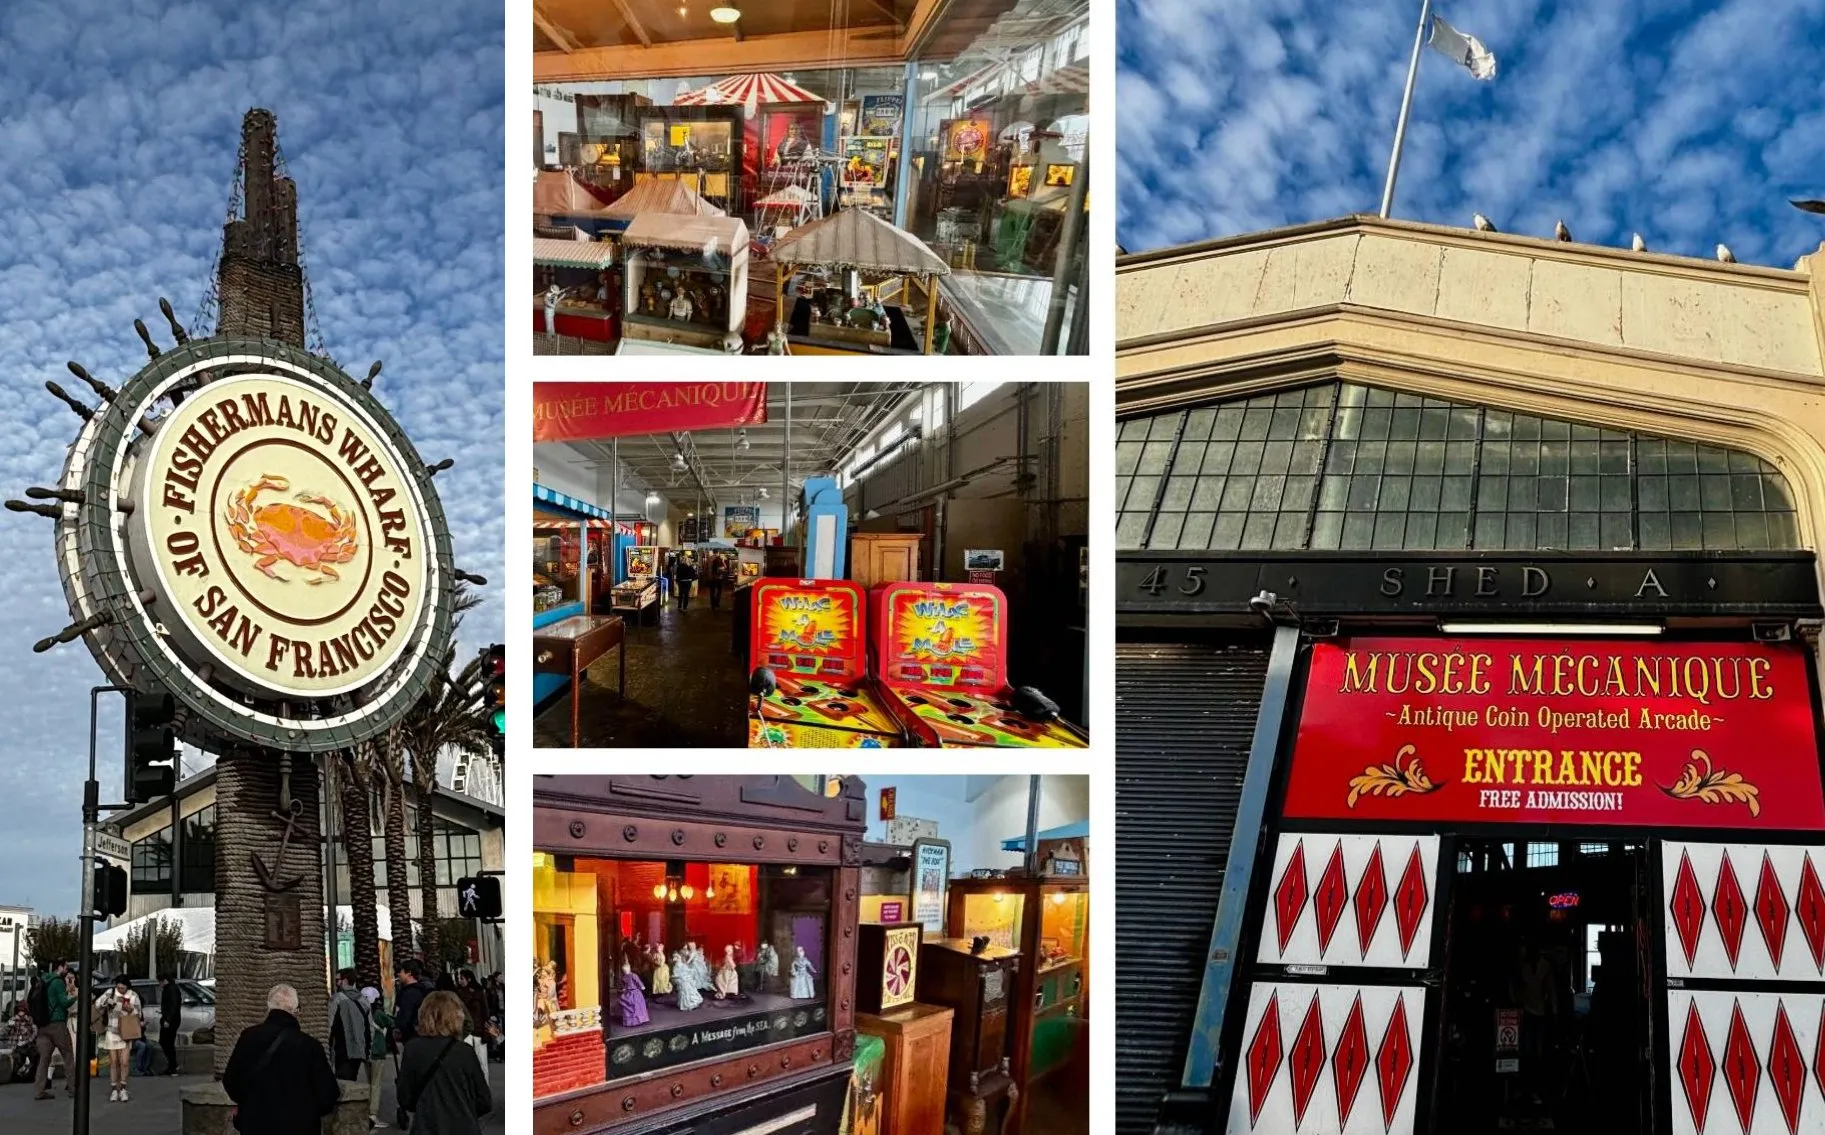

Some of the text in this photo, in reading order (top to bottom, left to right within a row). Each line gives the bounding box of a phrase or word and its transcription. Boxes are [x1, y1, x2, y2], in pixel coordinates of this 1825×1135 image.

[163, 392, 412, 559] FISHERMANS WHARF
[1139, 565, 1669, 597] 45 SHED A
[166, 531, 411, 679] OF SAN FRANCISCO
[1339, 645, 1774, 705] MUSÉE MÉCANIQUE
[1485, 705, 1530, 727] Coin
[1537, 706, 1630, 734] Operated
[1461, 748, 1643, 787] ENTRANCE
[1478, 789, 1624, 811] FREE ADMISSION!
[97, 836, 129, 856] Jefferson
[1549, 895, 1579, 907] OPEN
[0, 917, 13, 926] AN
[691, 1032, 699, 1045] A
